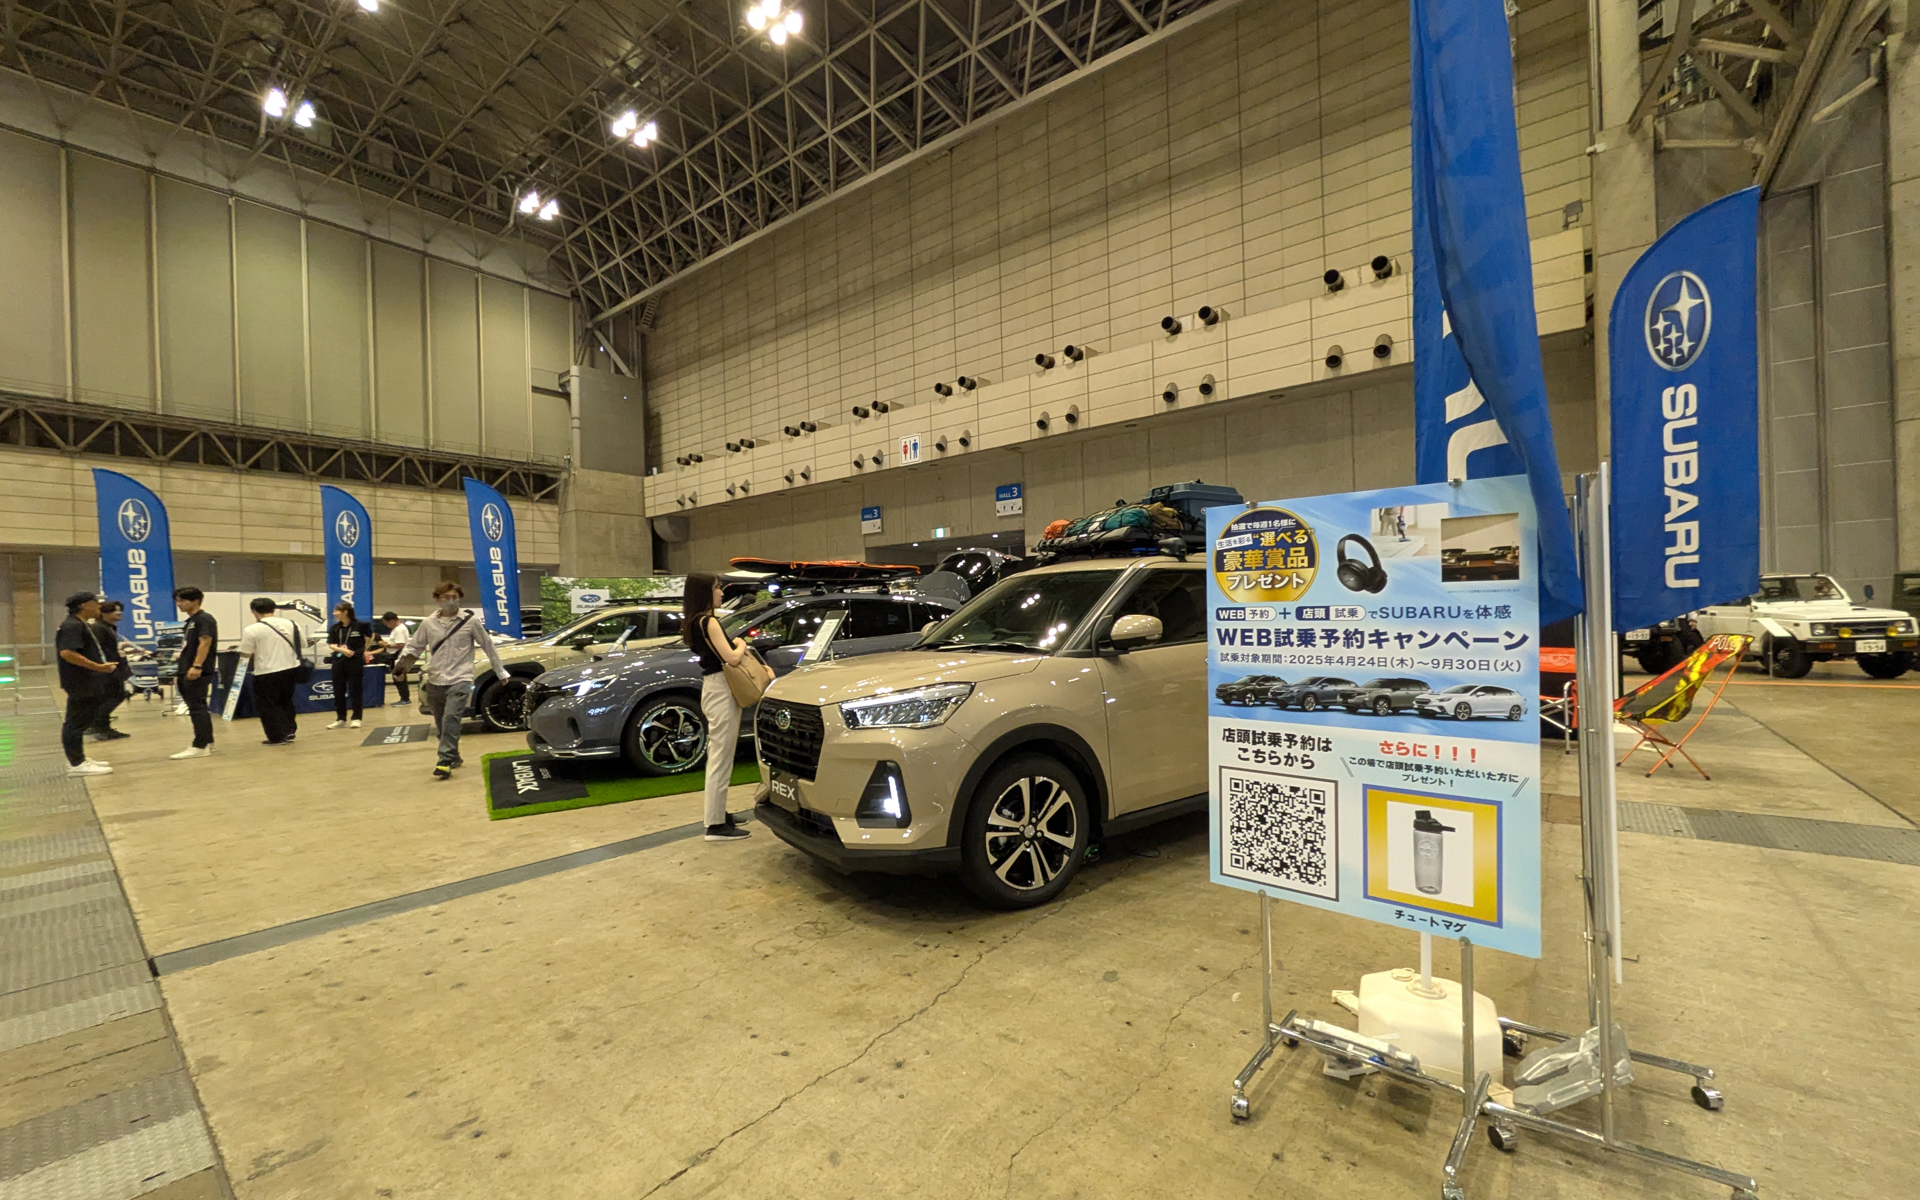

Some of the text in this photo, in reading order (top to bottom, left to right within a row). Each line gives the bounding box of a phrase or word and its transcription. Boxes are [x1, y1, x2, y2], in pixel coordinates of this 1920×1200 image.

[1012, 487, 1018, 497] 3
[1661, 383, 1700, 588] SUBARU
[873, 509, 878, 518] 3
[1217, 536, 1252, 549] 生活を彩る
[1223, 546, 1309, 571] 豪華賞品
[1227, 572, 1304, 590] プレゼント
[1218, 610, 1245, 620] WEB
[1248, 609, 1270, 620] 予約
[1302, 607, 1326, 620] 店頭
[1334, 607, 1359, 619] 試乗
[1216, 627, 1530, 651] WEB試乗予約キャンペーン
[1222, 727, 1333, 753] 店頭試乗予約は
[1237, 746, 1315, 770] こちらから
[512, 759, 540, 795] LAYBACK
[772, 779, 796, 801] REX
[1394, 909, 1467, 933] チュートマグ
